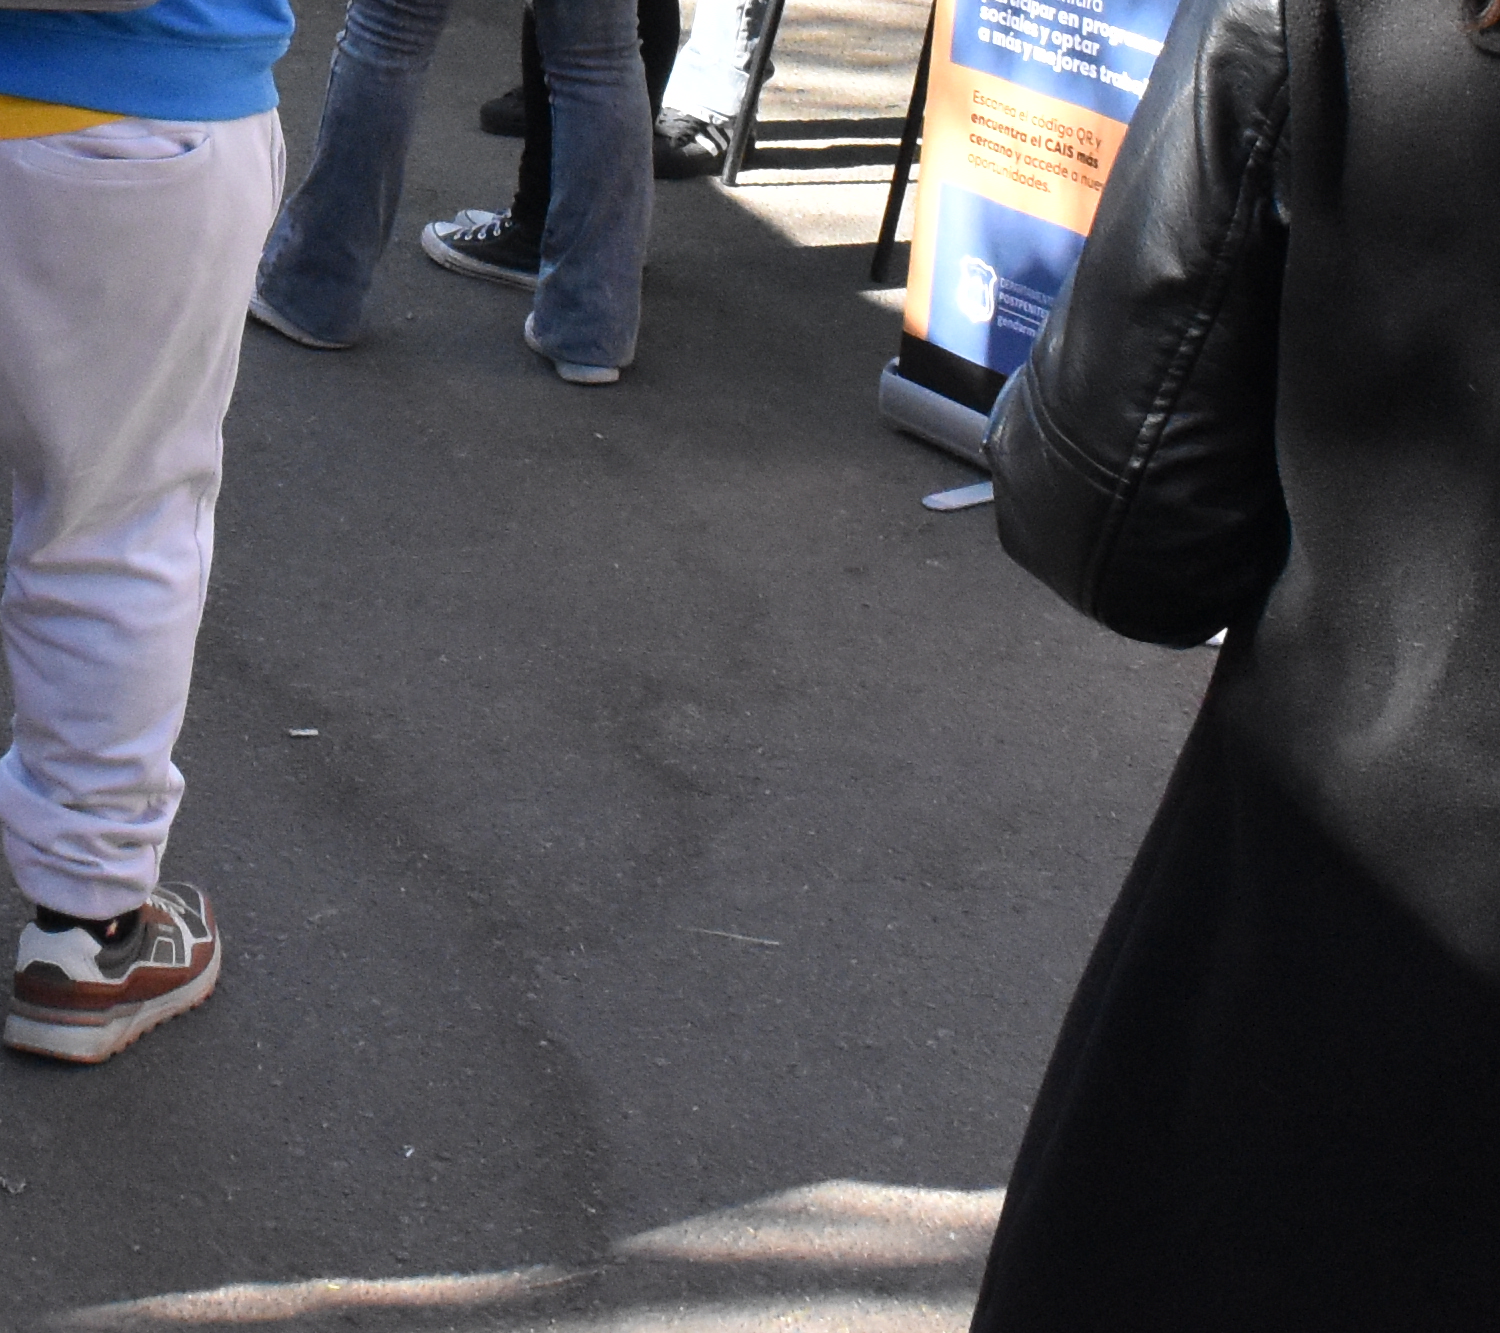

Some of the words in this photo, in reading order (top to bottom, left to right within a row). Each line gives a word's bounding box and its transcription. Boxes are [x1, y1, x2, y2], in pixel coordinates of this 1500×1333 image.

[980, 5, 1038, 38] sociales
[1039, 26, 1050, 45] y
[1051, 31, 1100, 56] optar
[1058, 10, 1079, 28] en
[978, 26, 990, 42] a
[993, 31, 1021, 54] más
[1022, 41, 1033, 61] y
[1033, 44, 1097, 78] mejores
[971, 113, 1027, 142] encuentra
[1030, 135, 1042, 148] el
[1045, 138, 1074, 159] CAIS
[1077, 150, 1099, 169] más
[972, 89, 1016, 118] Escanea
[1019, 109, 1028, 122] el
[1031, 114, 1073, 138] código
[1076, 127, 1094, 145] QR
[969, 133, 1012, 158] cercano
[1015, 150, 1022, 164] y
[1024, 154, 1068, 179] accede
[1071, 170, 1078, 182] a
